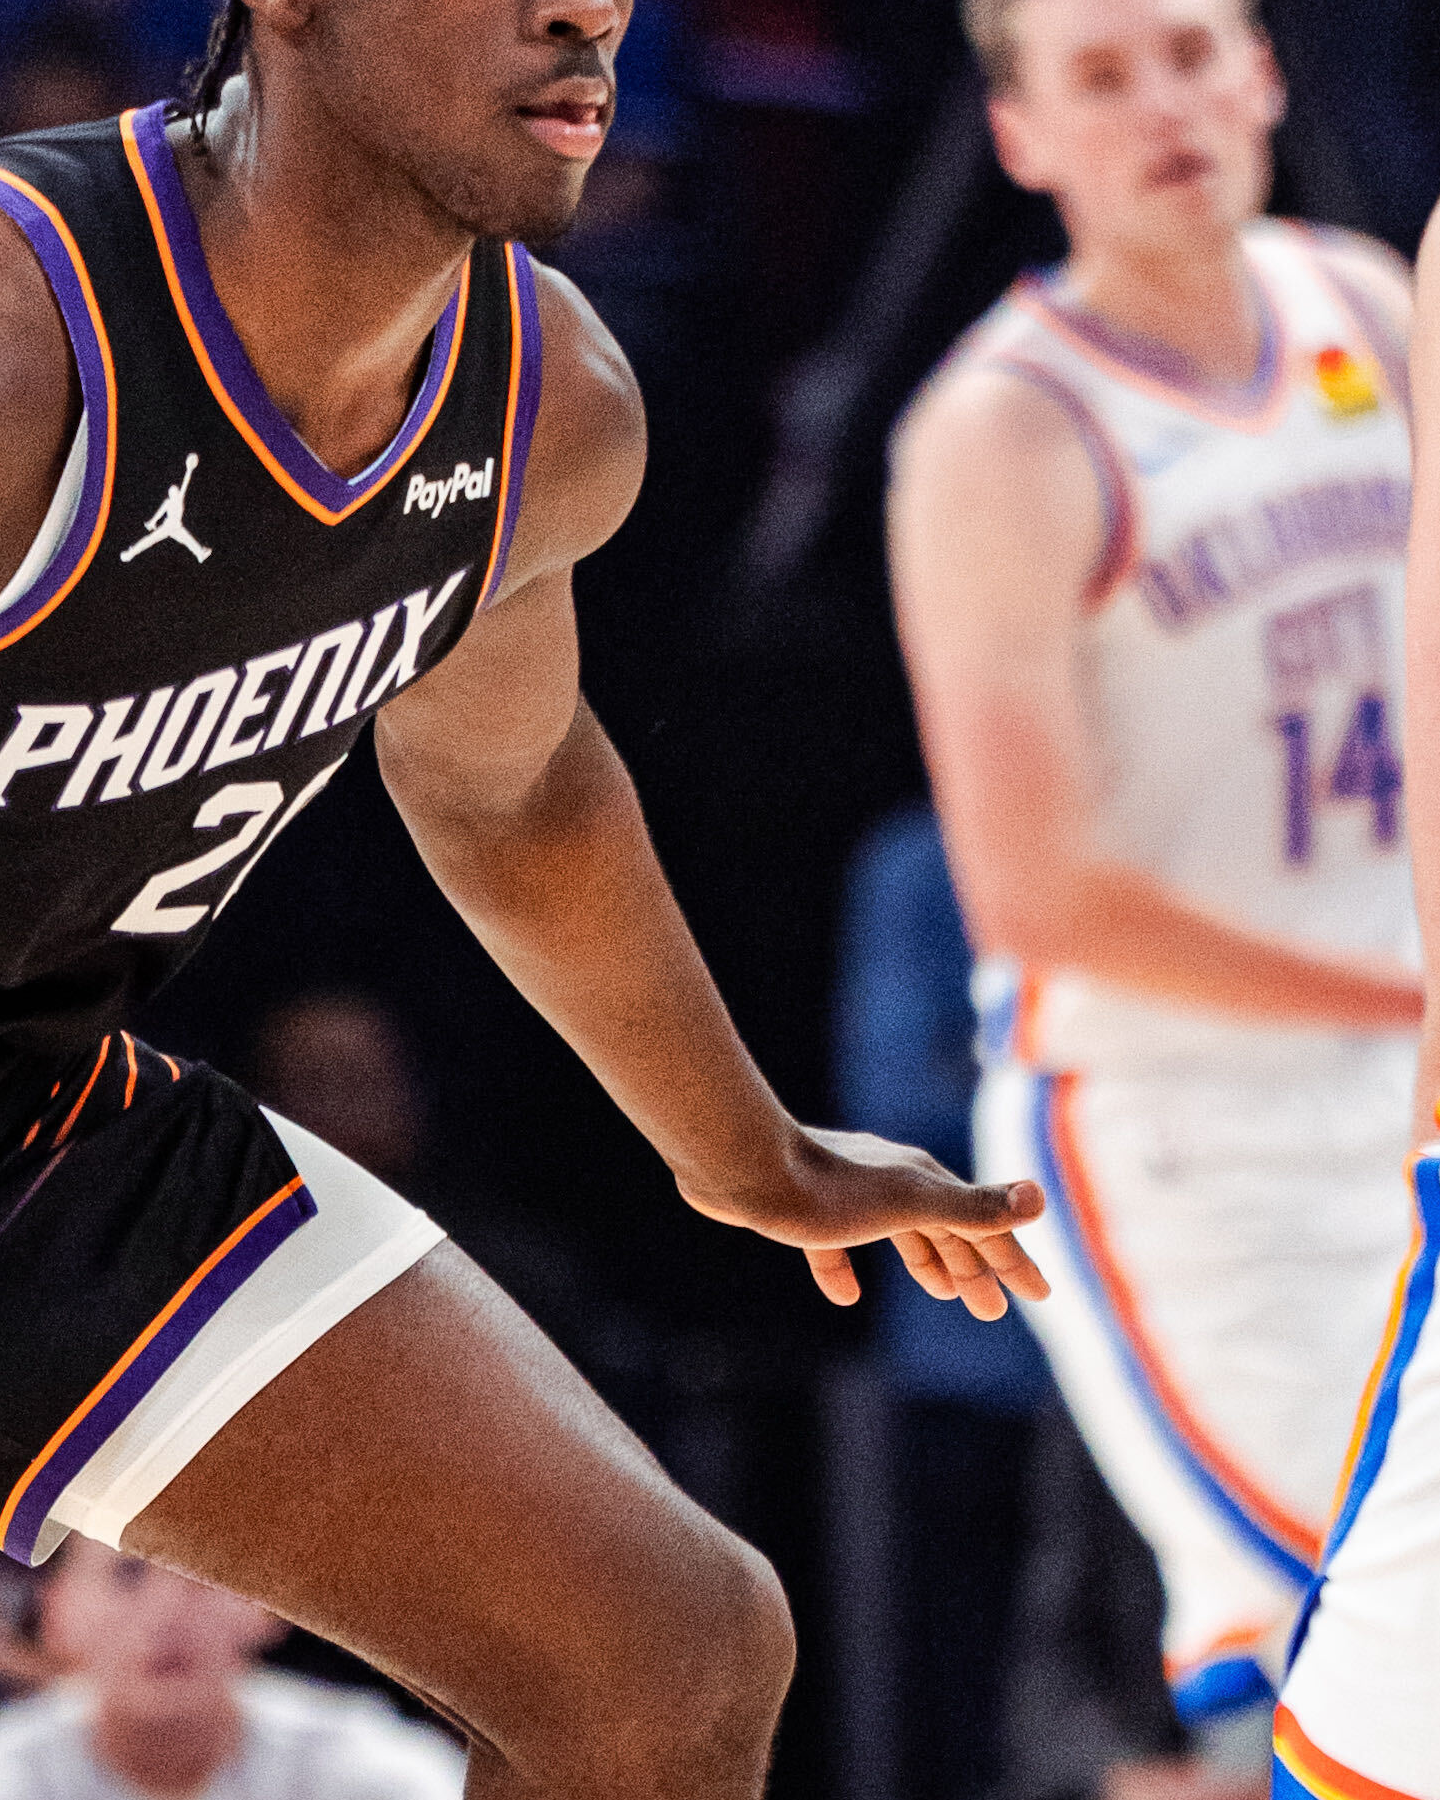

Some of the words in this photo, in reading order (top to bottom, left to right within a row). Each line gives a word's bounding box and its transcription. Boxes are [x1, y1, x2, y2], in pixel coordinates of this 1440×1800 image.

[403, 457, 495, 519] PayPal
[110, 753, 349, 934] 2
[1273, 693, 1403, 867] 14
